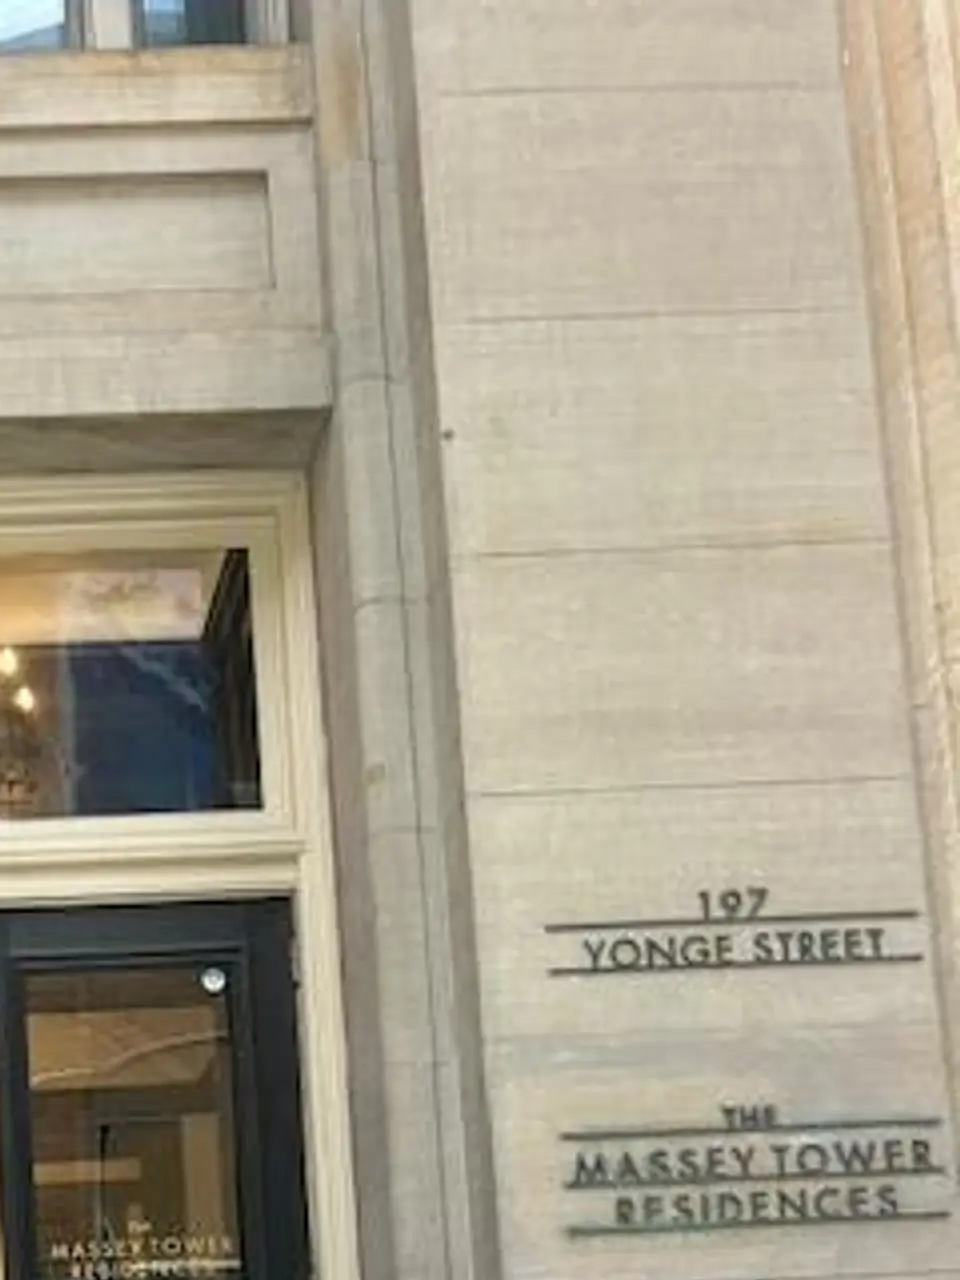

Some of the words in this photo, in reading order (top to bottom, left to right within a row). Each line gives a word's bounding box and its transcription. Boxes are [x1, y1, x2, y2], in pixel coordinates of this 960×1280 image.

[697, 886, 769, 922] 197
[583, 934, 734, 972] YONGE
[752, 928, 885, 963] STREET
[720, 1104, 778, 1130] THE
[574, 1147, 756, 1186] MASSEY
[770, 1140, 932, 1177] TOWER
[616, 1184, 900, 1226] RESIDENCES
